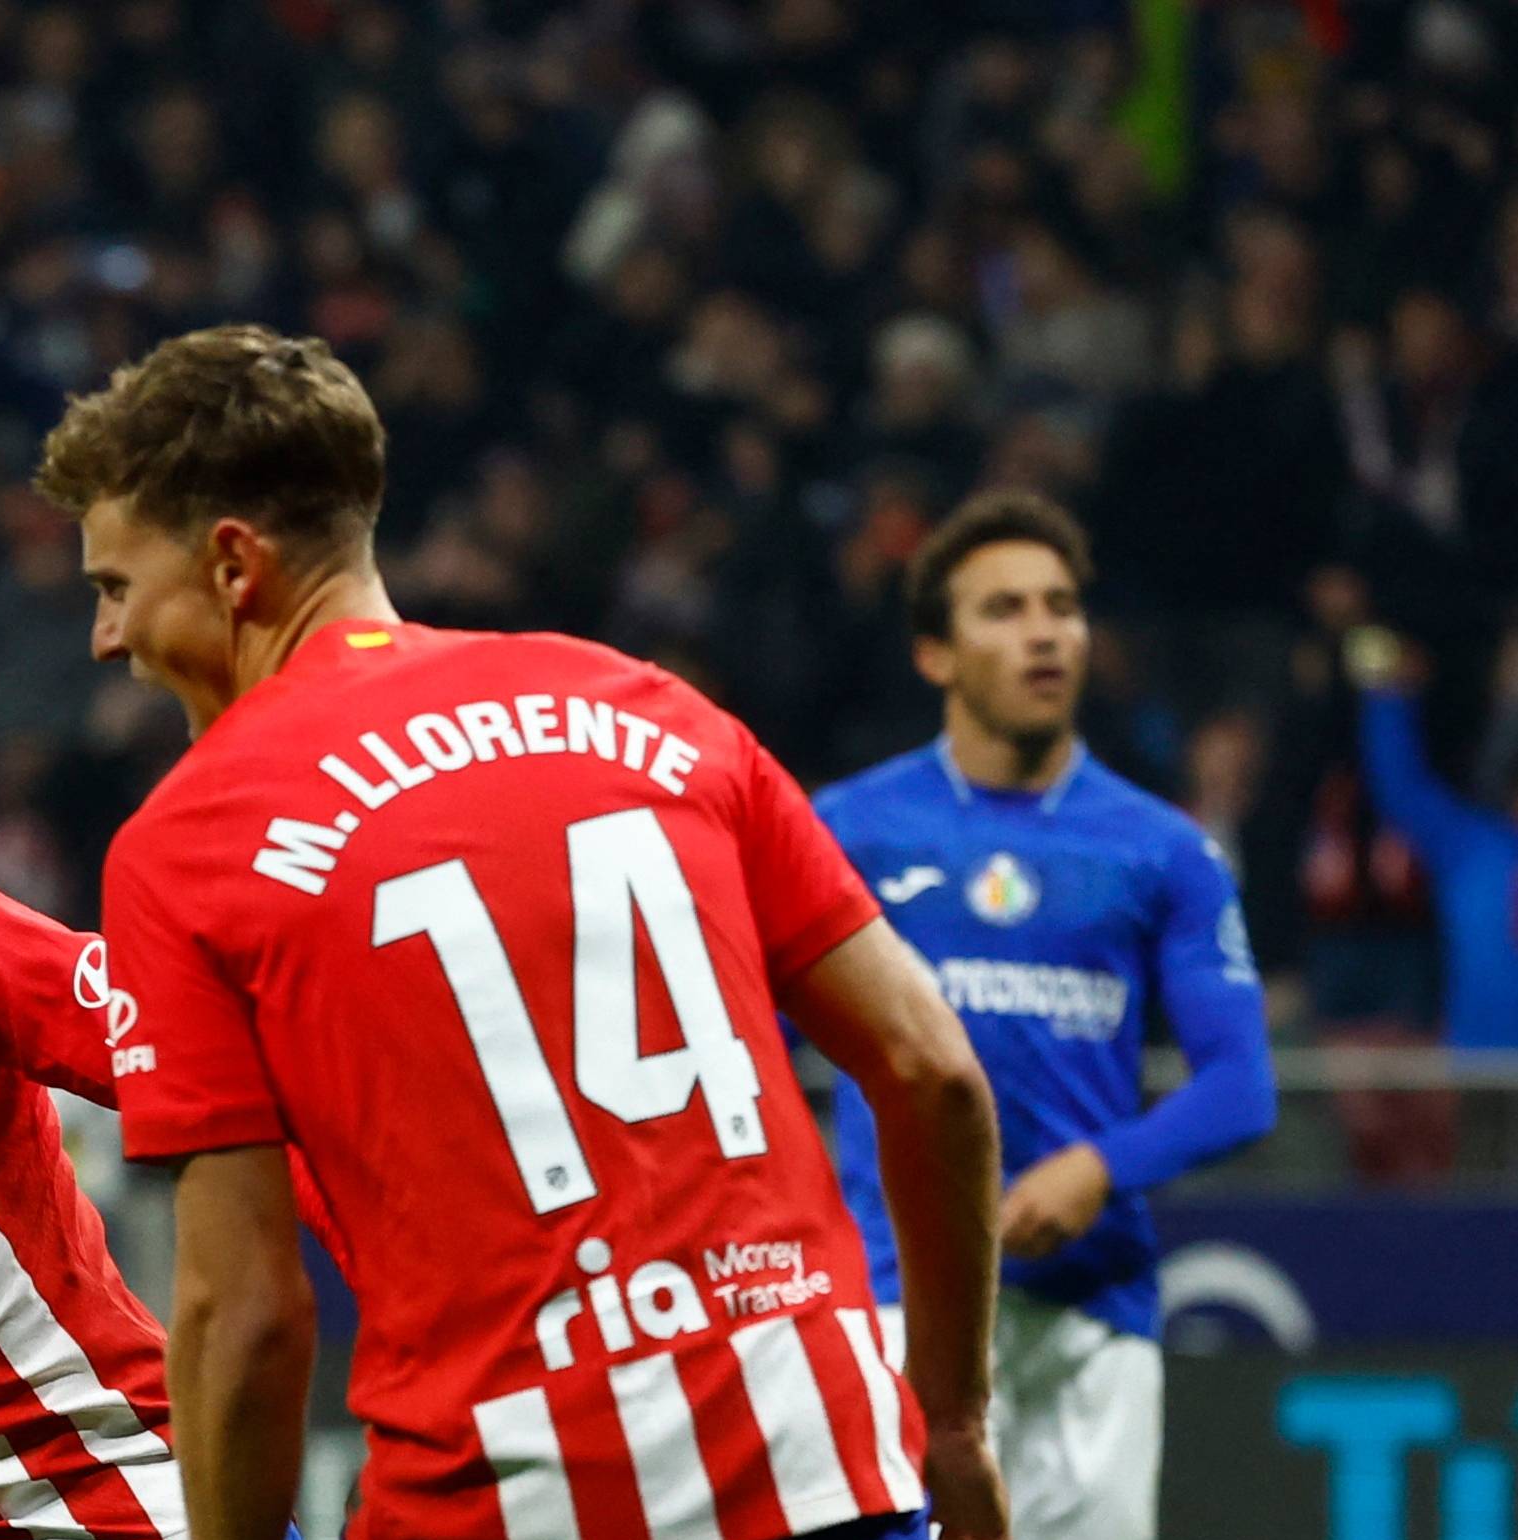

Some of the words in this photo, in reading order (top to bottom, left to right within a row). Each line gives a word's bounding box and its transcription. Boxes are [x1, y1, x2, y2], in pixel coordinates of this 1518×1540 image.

[252, 809, 361, 896] M.
[319, 693, 701, 811] LLORENTE
[371, 806, 768, 1216] 14
[535, 1236, 711, 1372] ria
[703, 1240, 803, 1284] Money
